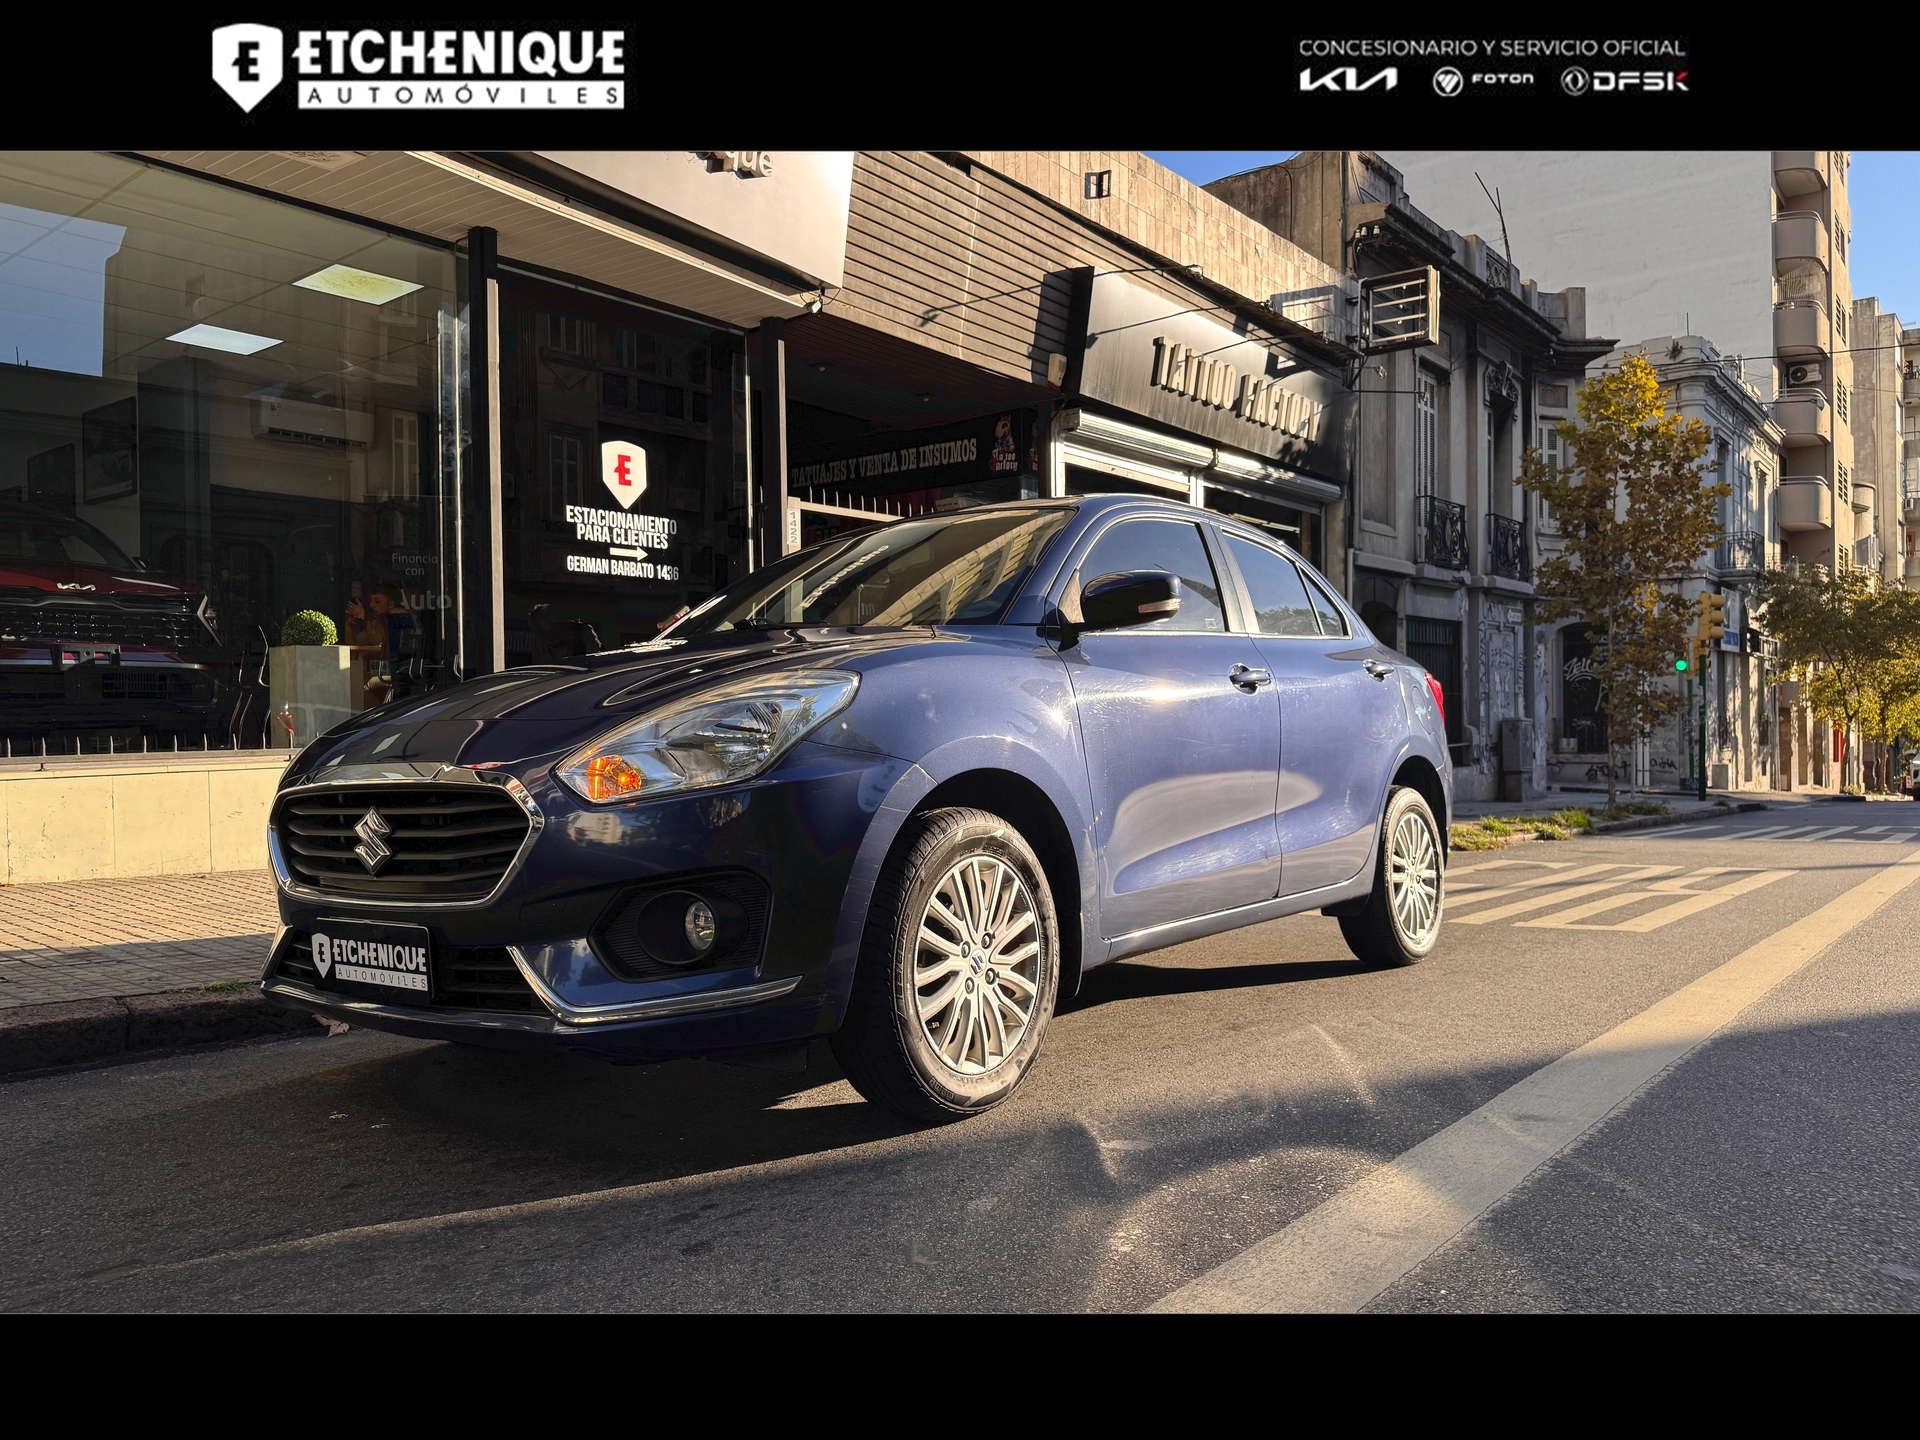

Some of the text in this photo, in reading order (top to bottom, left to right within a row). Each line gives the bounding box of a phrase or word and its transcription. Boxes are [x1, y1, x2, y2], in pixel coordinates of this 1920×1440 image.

[1154, 337, 1324, 442] TATTOO FACTORY
[792, 438, 977, 488] TATUAJES Y VENTA DE INSUMOS
[565, 504, 678, 536] ESTACIONAMIENTO
[576, 523, 668, 550] PARA CLIENTES
[391, 552, 438, 564] Financia
[405, 567, 425, 576] con
[566, 555, 679, 581] GERMAN BARBATO 1436
[332, 938, 427, 972] ETCHENIQUE
[337, 967, 427, 989] AUTOMÓVILES
